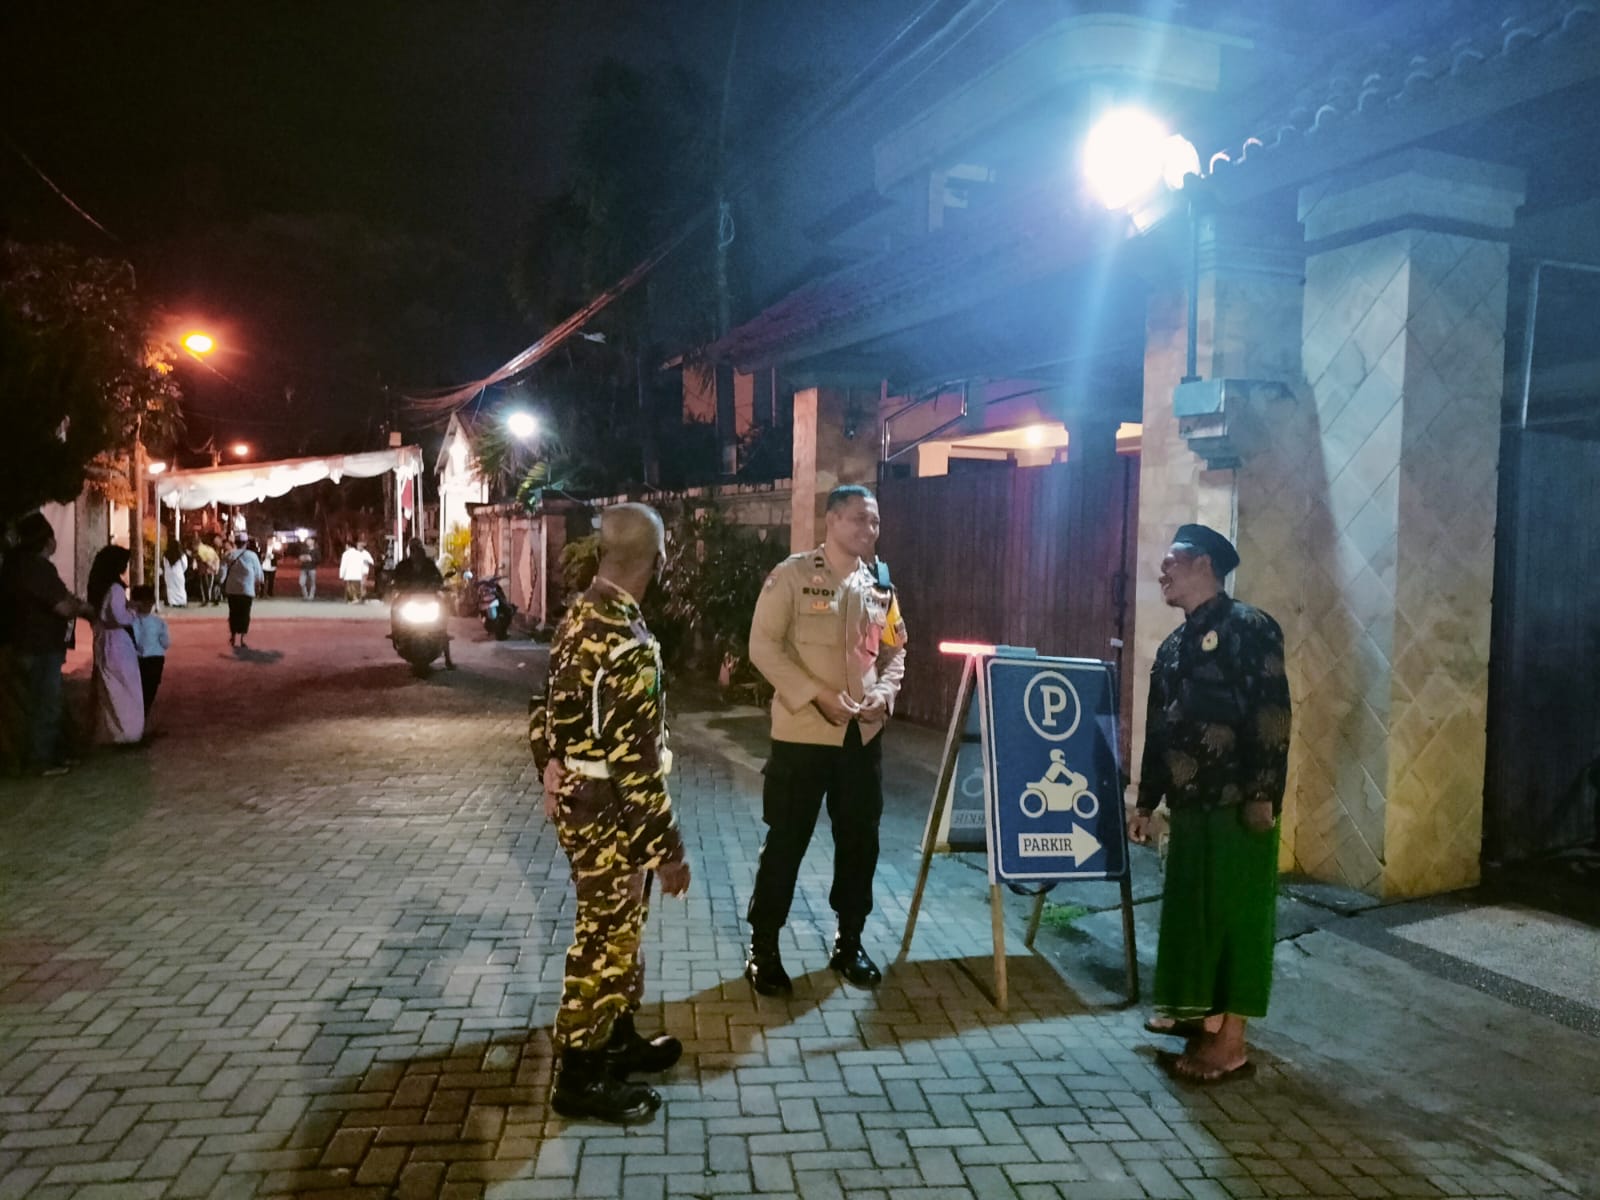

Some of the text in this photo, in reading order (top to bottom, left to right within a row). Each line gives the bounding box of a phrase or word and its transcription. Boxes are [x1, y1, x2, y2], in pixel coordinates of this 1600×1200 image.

[802, 586, 835, 597] RUDI
[1040, 685, 1067, 727] P
[1023, 838, 1073, 852] PARKIR
